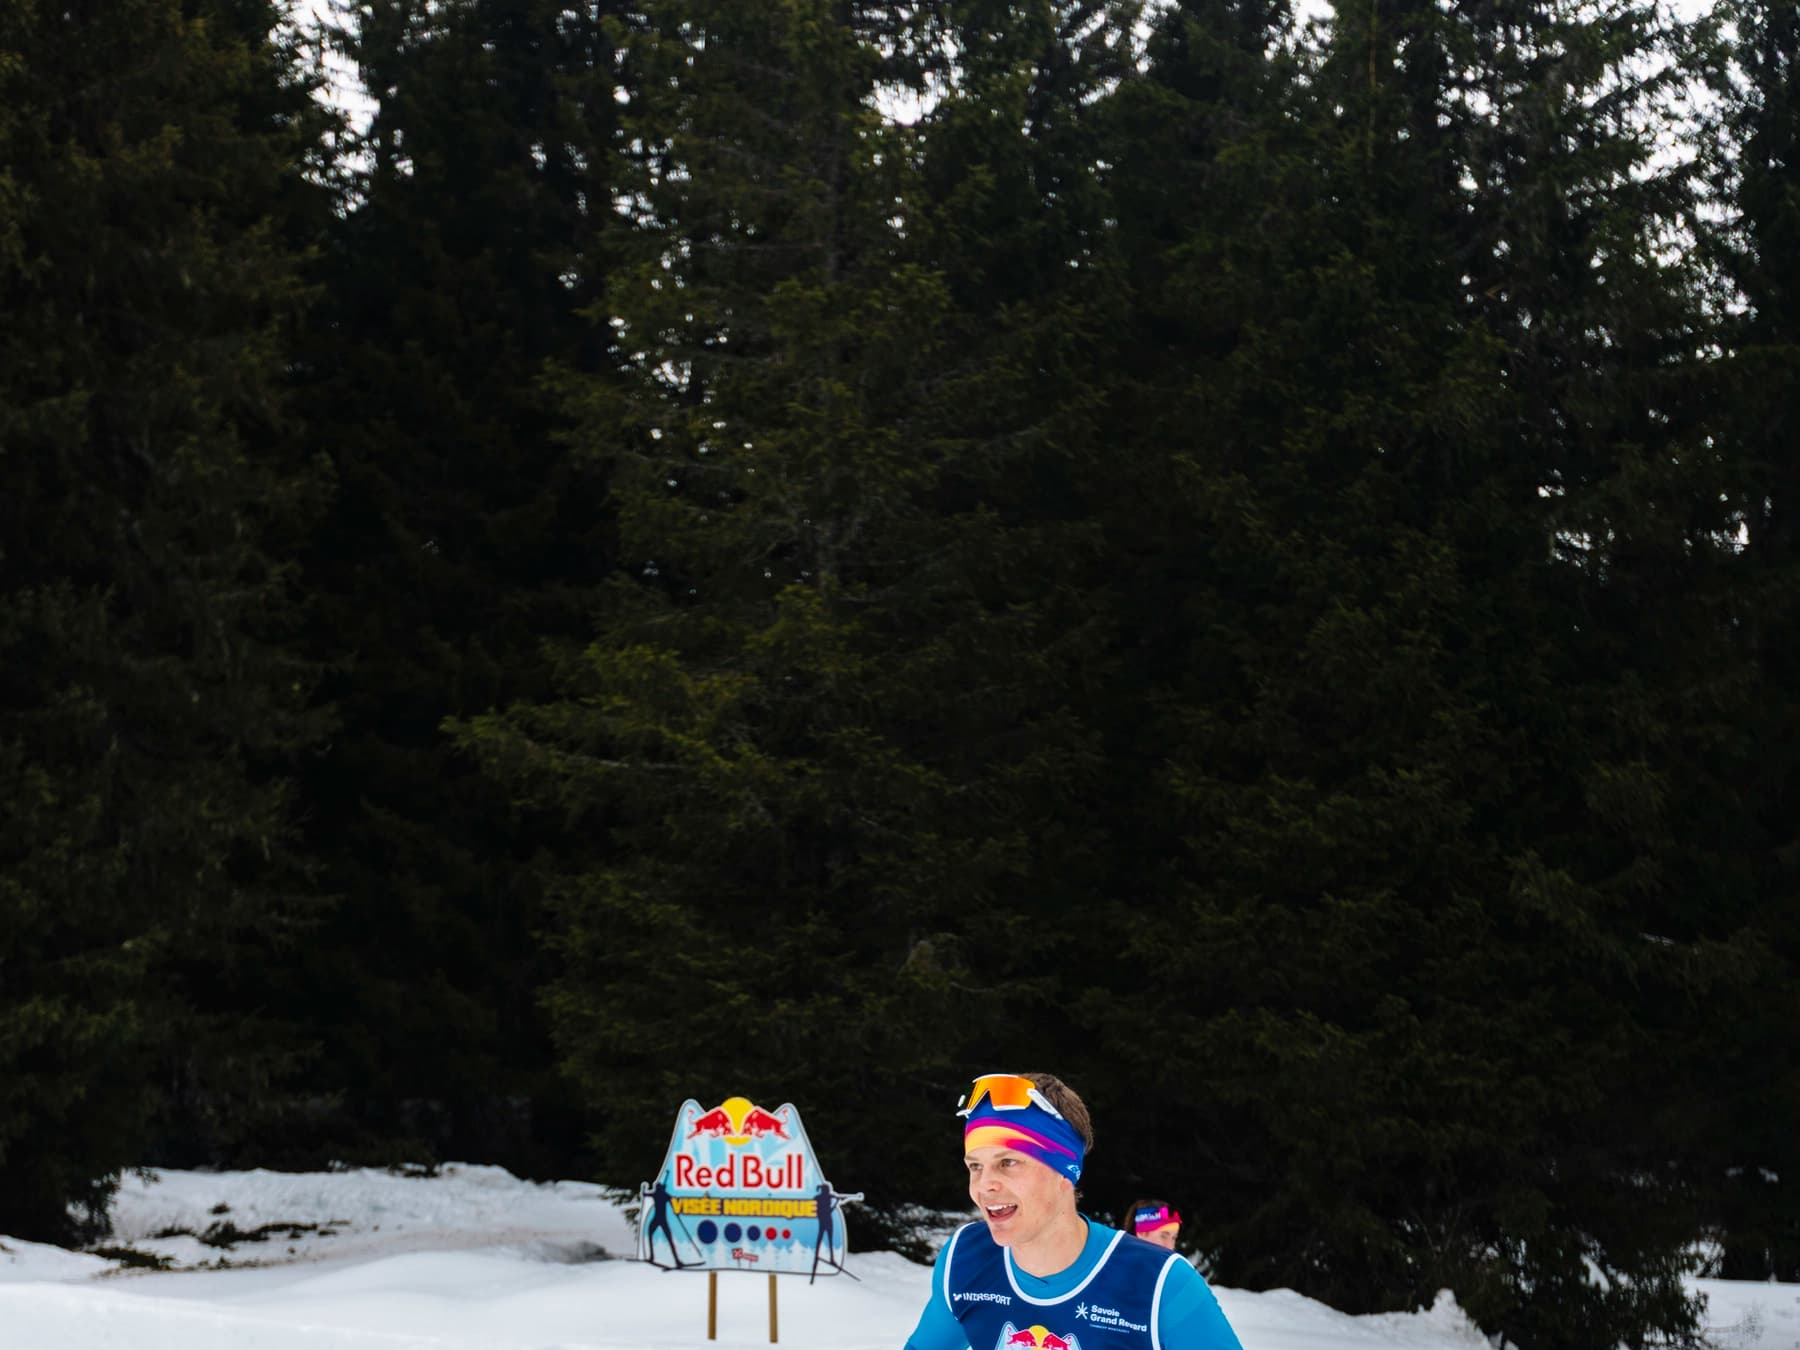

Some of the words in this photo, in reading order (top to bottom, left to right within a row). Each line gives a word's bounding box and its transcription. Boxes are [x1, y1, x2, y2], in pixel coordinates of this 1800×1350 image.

[675, 1153, 735, 1188] Red
[742, 1153, 803, 1189] Bull
[671, 1193, 722, 1215] VISÉE
[723, 1199, 818, 1219] NORDIQUE
[1090, 1313, 1117, 1325] Grand
[1091, 1304, 1120, 1317] Savoie
